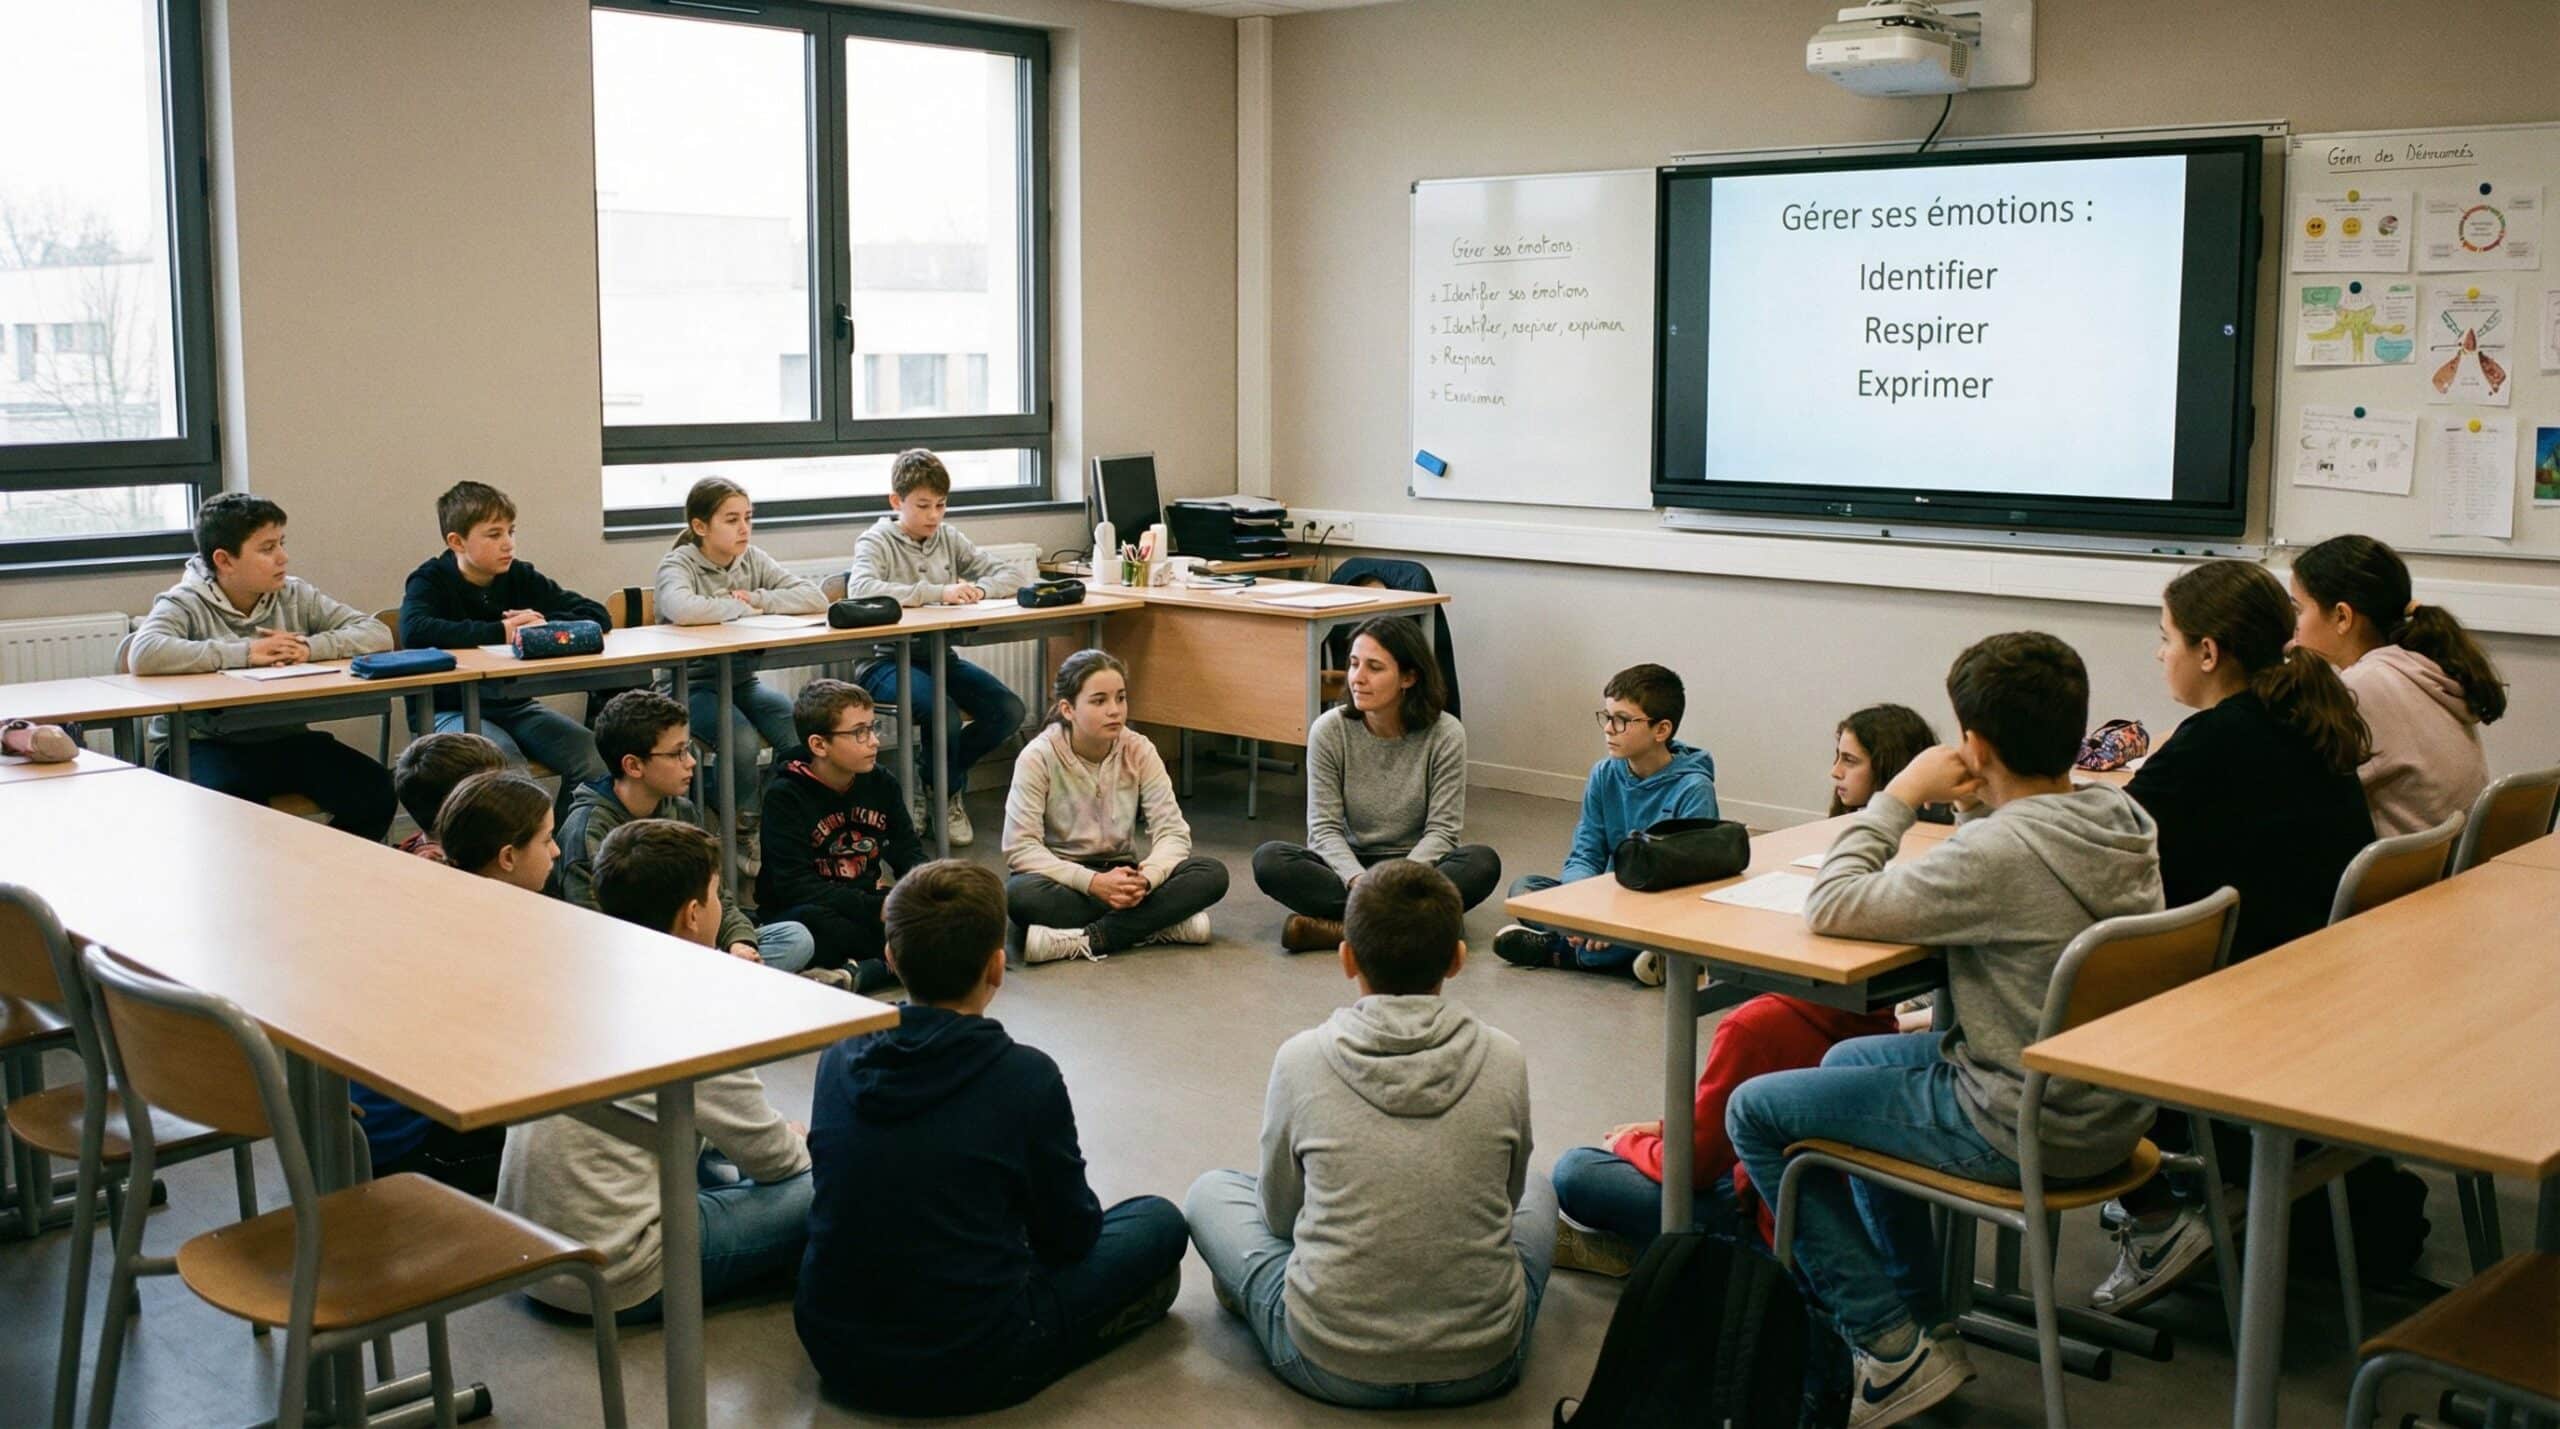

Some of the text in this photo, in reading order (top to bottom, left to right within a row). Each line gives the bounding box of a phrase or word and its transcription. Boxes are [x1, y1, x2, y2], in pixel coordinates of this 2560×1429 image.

[2374, 149, 2394, 163] des
[1782, 195, 2093, 231] Gérer ses émotions :
[1493, 246, 1511, 257] ses
[1508, 289, 1526, 300] ses
[1532, 280, 1589, 299] émotions
[1859, 260, 1998, 290] Identifier
[1865, 316, 1989, 350] Respirer
[1858, 370, 1994, 404] Exprimer
